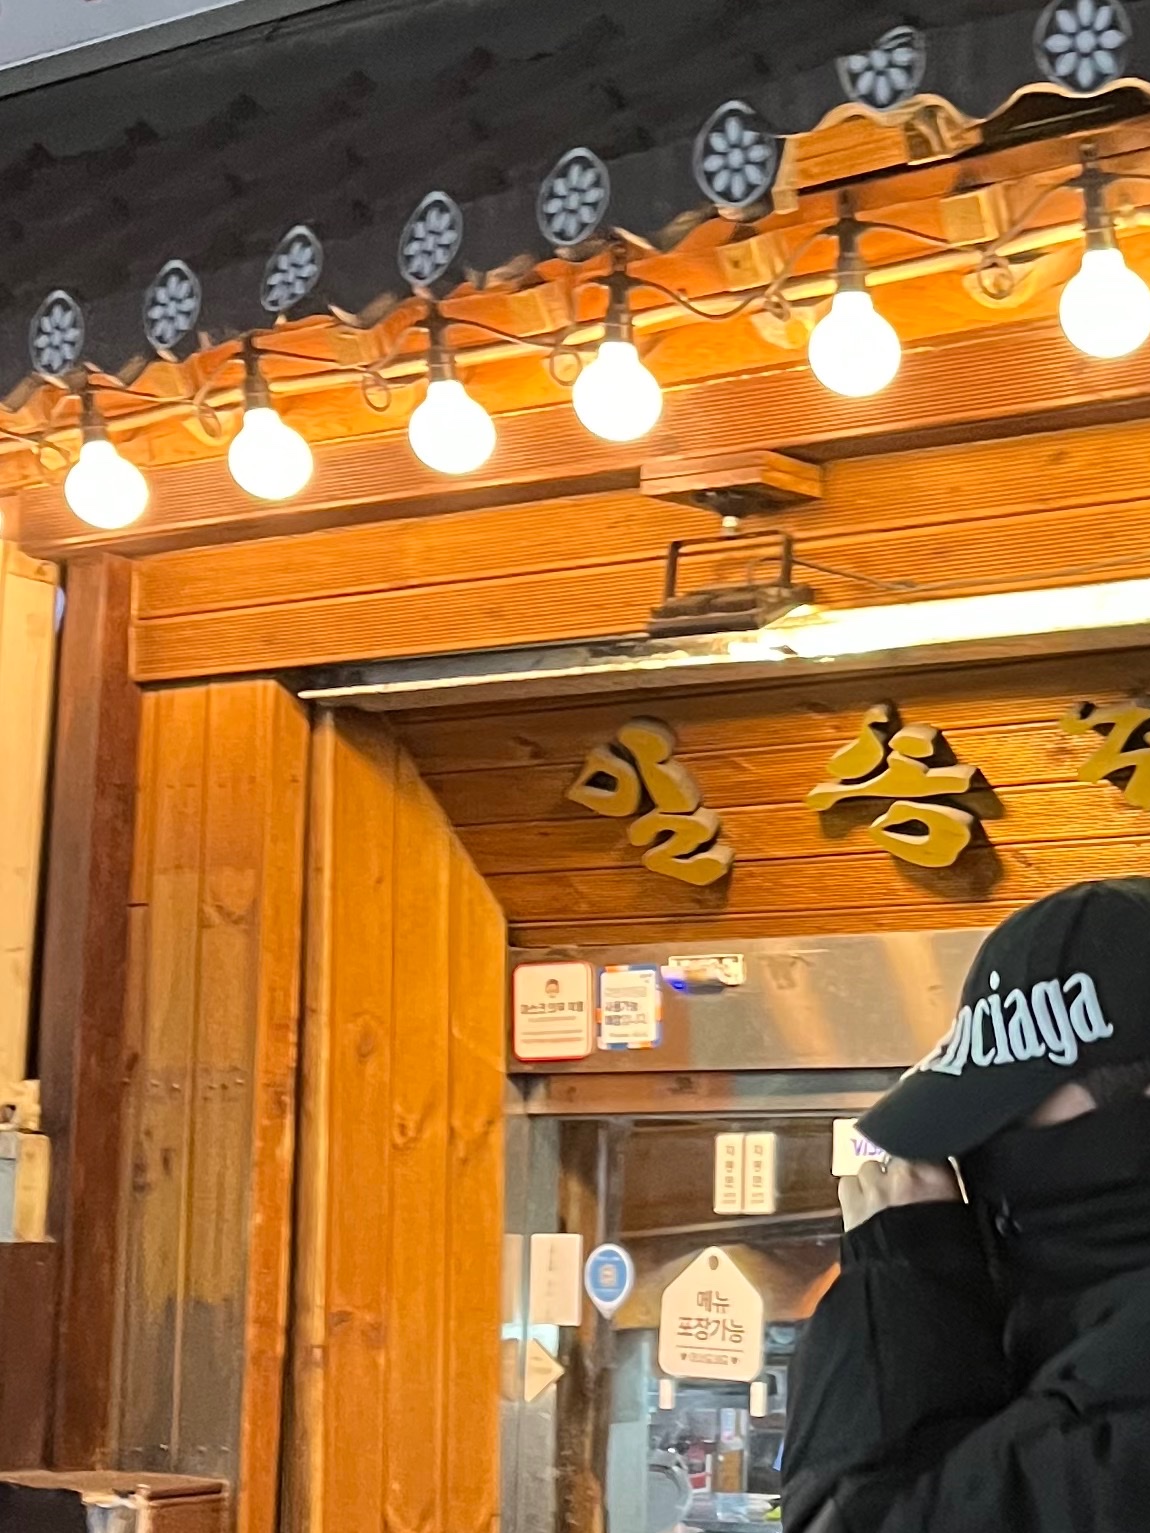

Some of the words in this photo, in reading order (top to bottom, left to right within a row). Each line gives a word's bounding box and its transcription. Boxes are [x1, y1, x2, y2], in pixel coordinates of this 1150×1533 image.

[901, 970, 1114, 1077] nciaga
[696, 1290, 730, 1314] 메뉴
[676, 1316, 745, 1343] 포장가능
